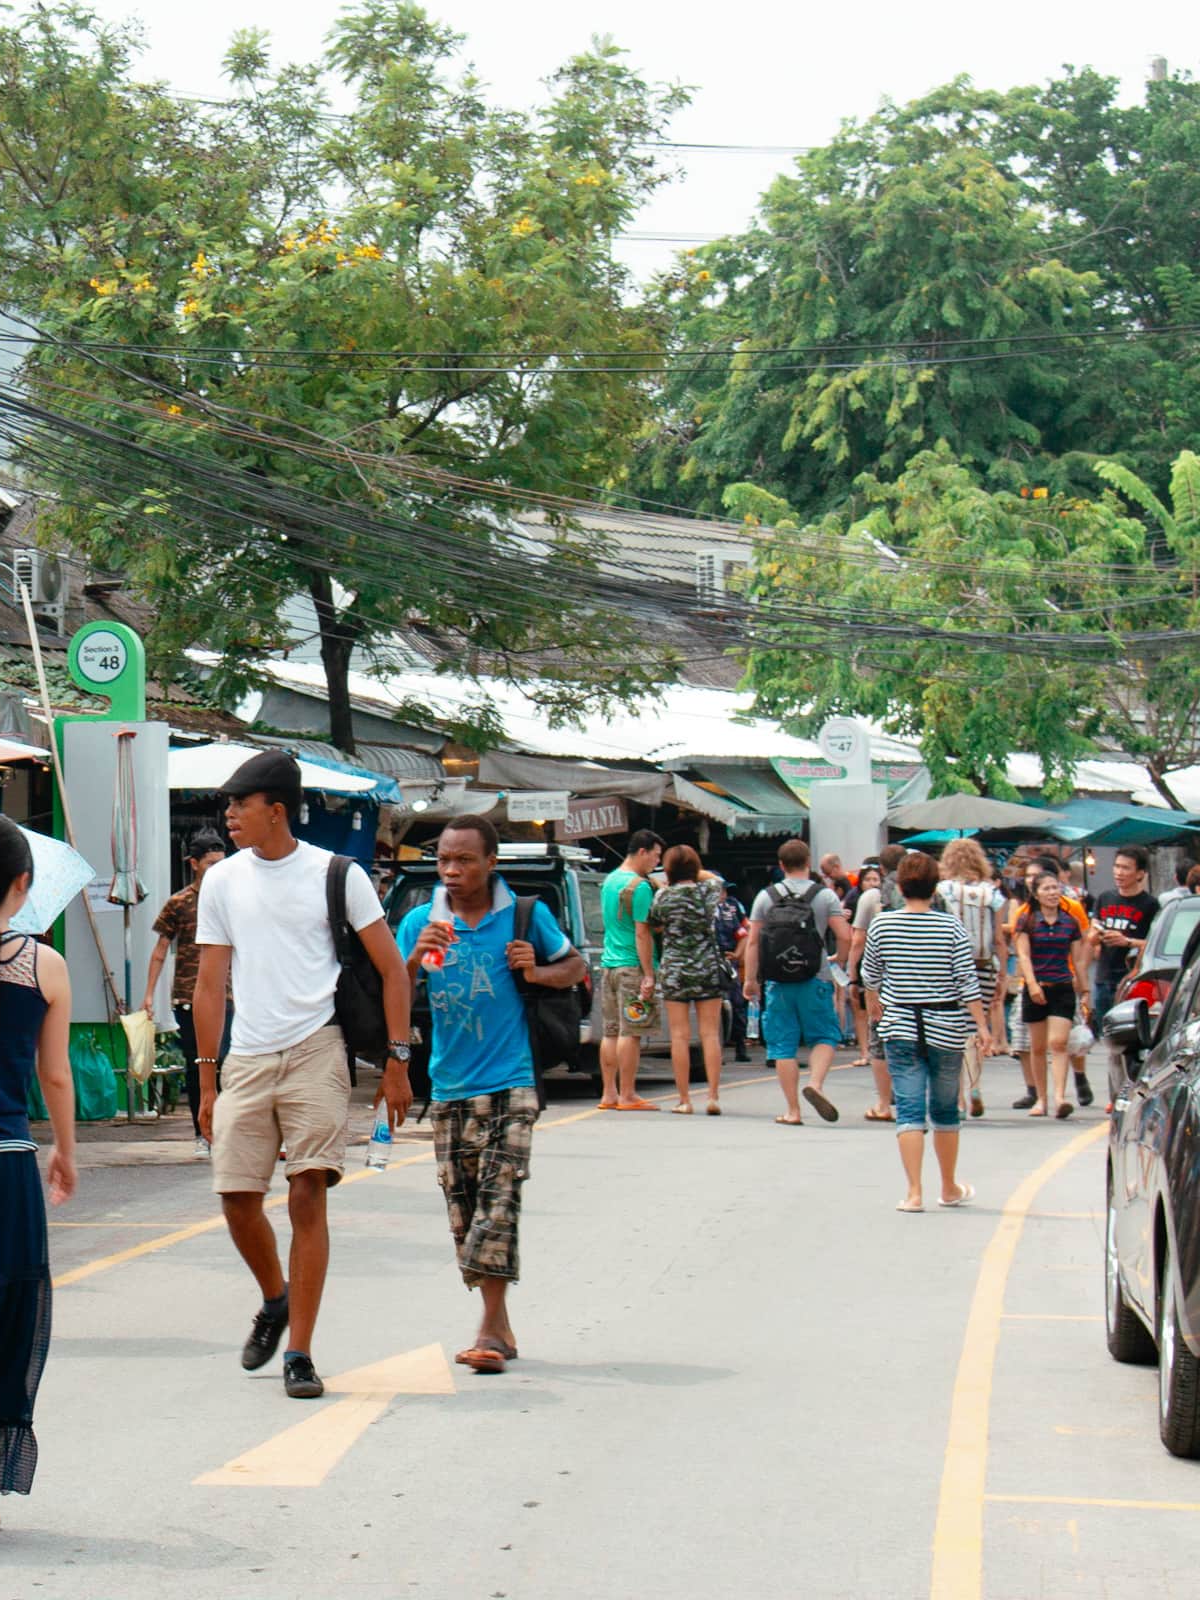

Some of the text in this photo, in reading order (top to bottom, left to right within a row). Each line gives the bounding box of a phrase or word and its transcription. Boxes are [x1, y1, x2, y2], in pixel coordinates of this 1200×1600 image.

[99, 655, 120, 670] 48
[838, 742, 852, 752] 47
[564, 805, 623, 834] SAWANYA
